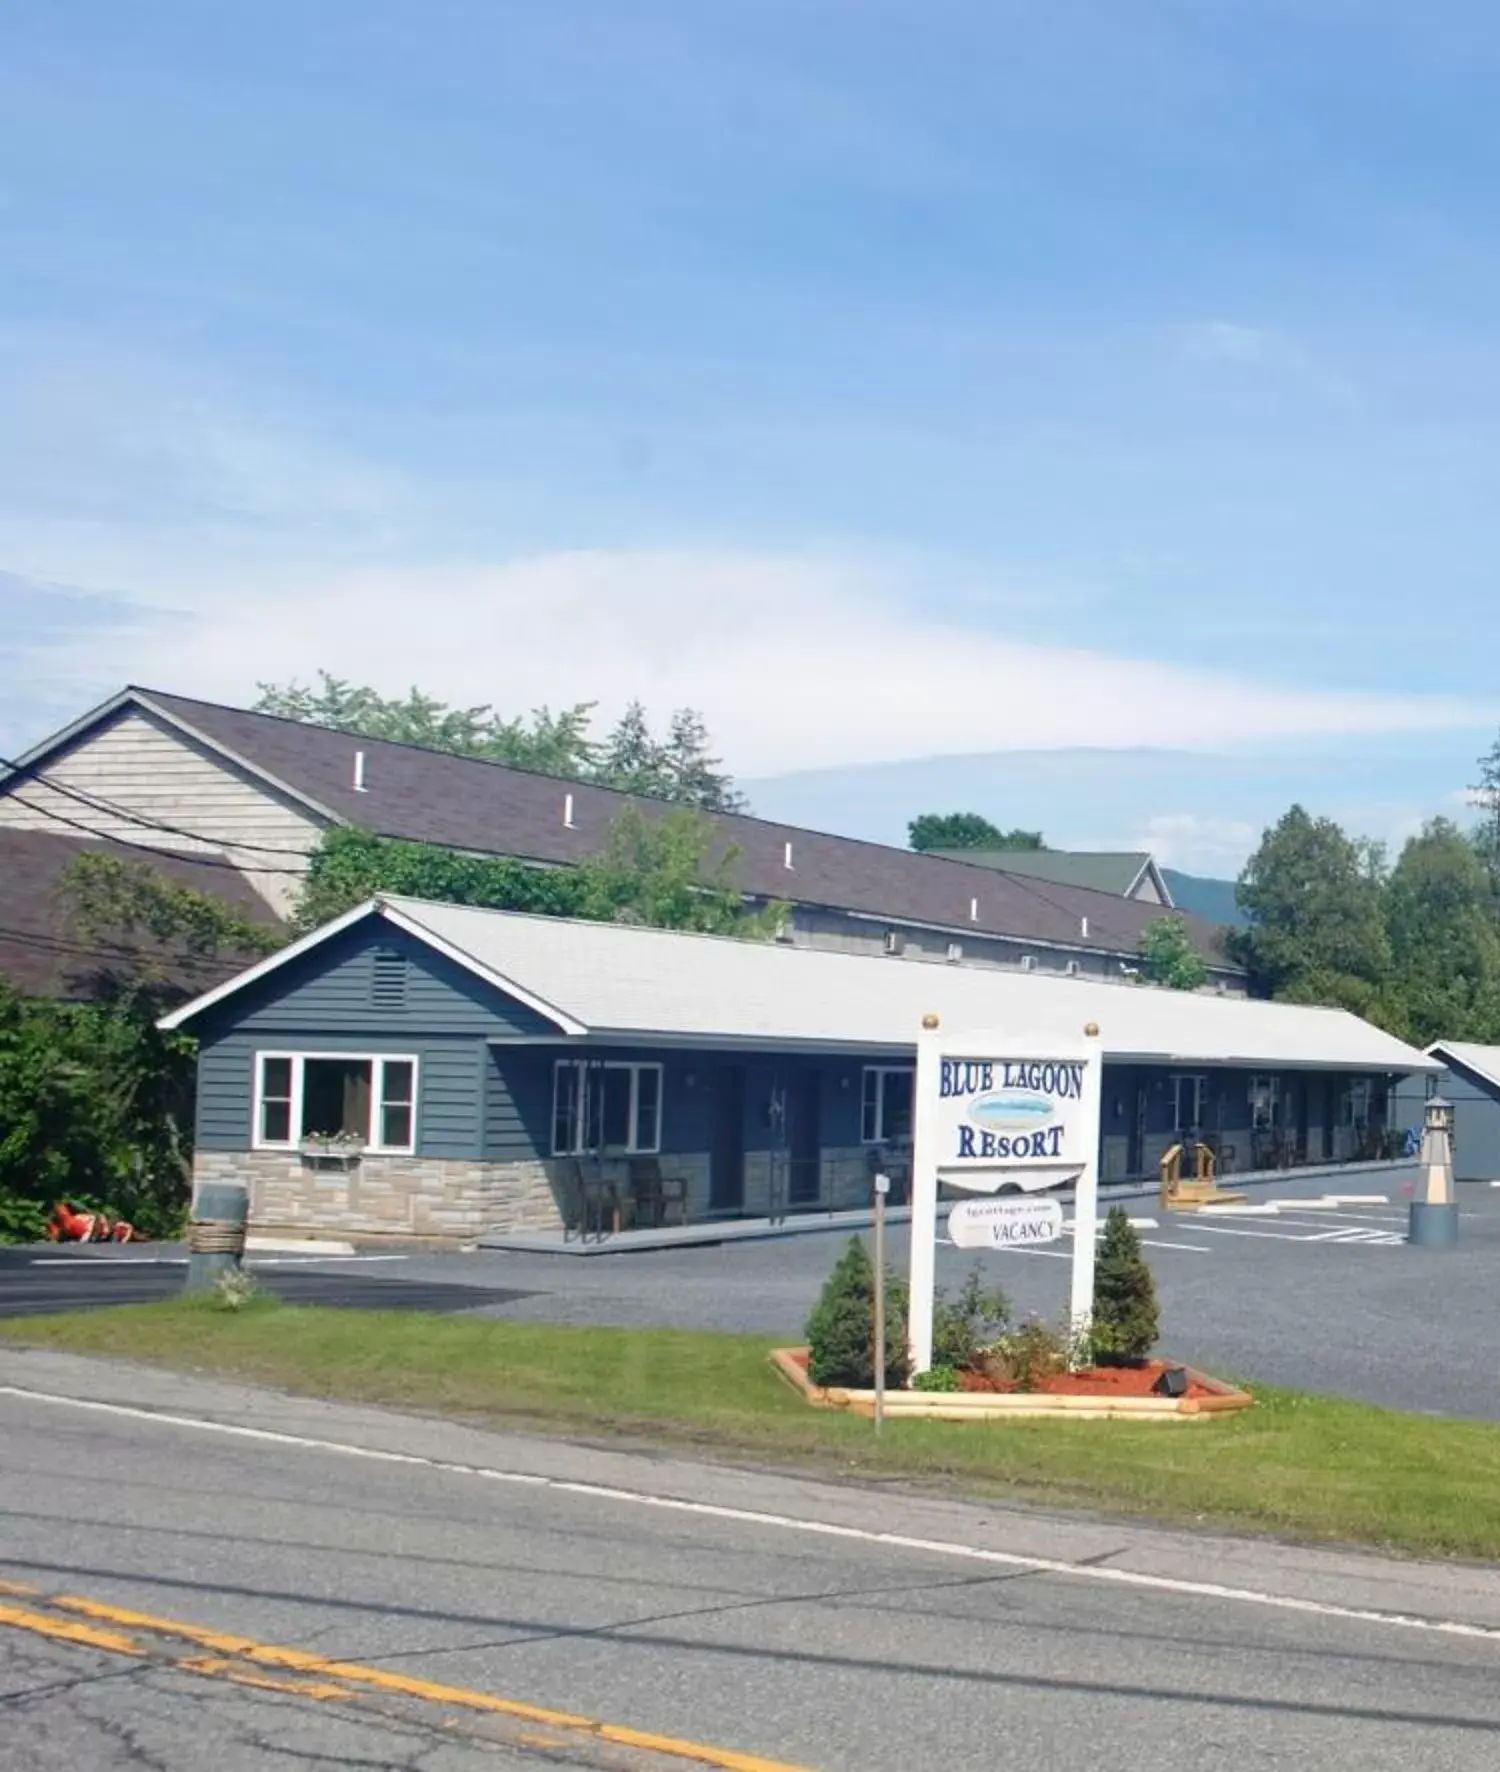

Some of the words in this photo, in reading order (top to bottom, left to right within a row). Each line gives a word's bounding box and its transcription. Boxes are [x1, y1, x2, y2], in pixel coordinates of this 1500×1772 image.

[940, 1061, 993, 1097] BLUE
[1003, 1062, 1084, 1099] LAGOON
[957, 1125, 1064, 1157] RESORT
[993, 1222, 1053, 1240] VACANCY
